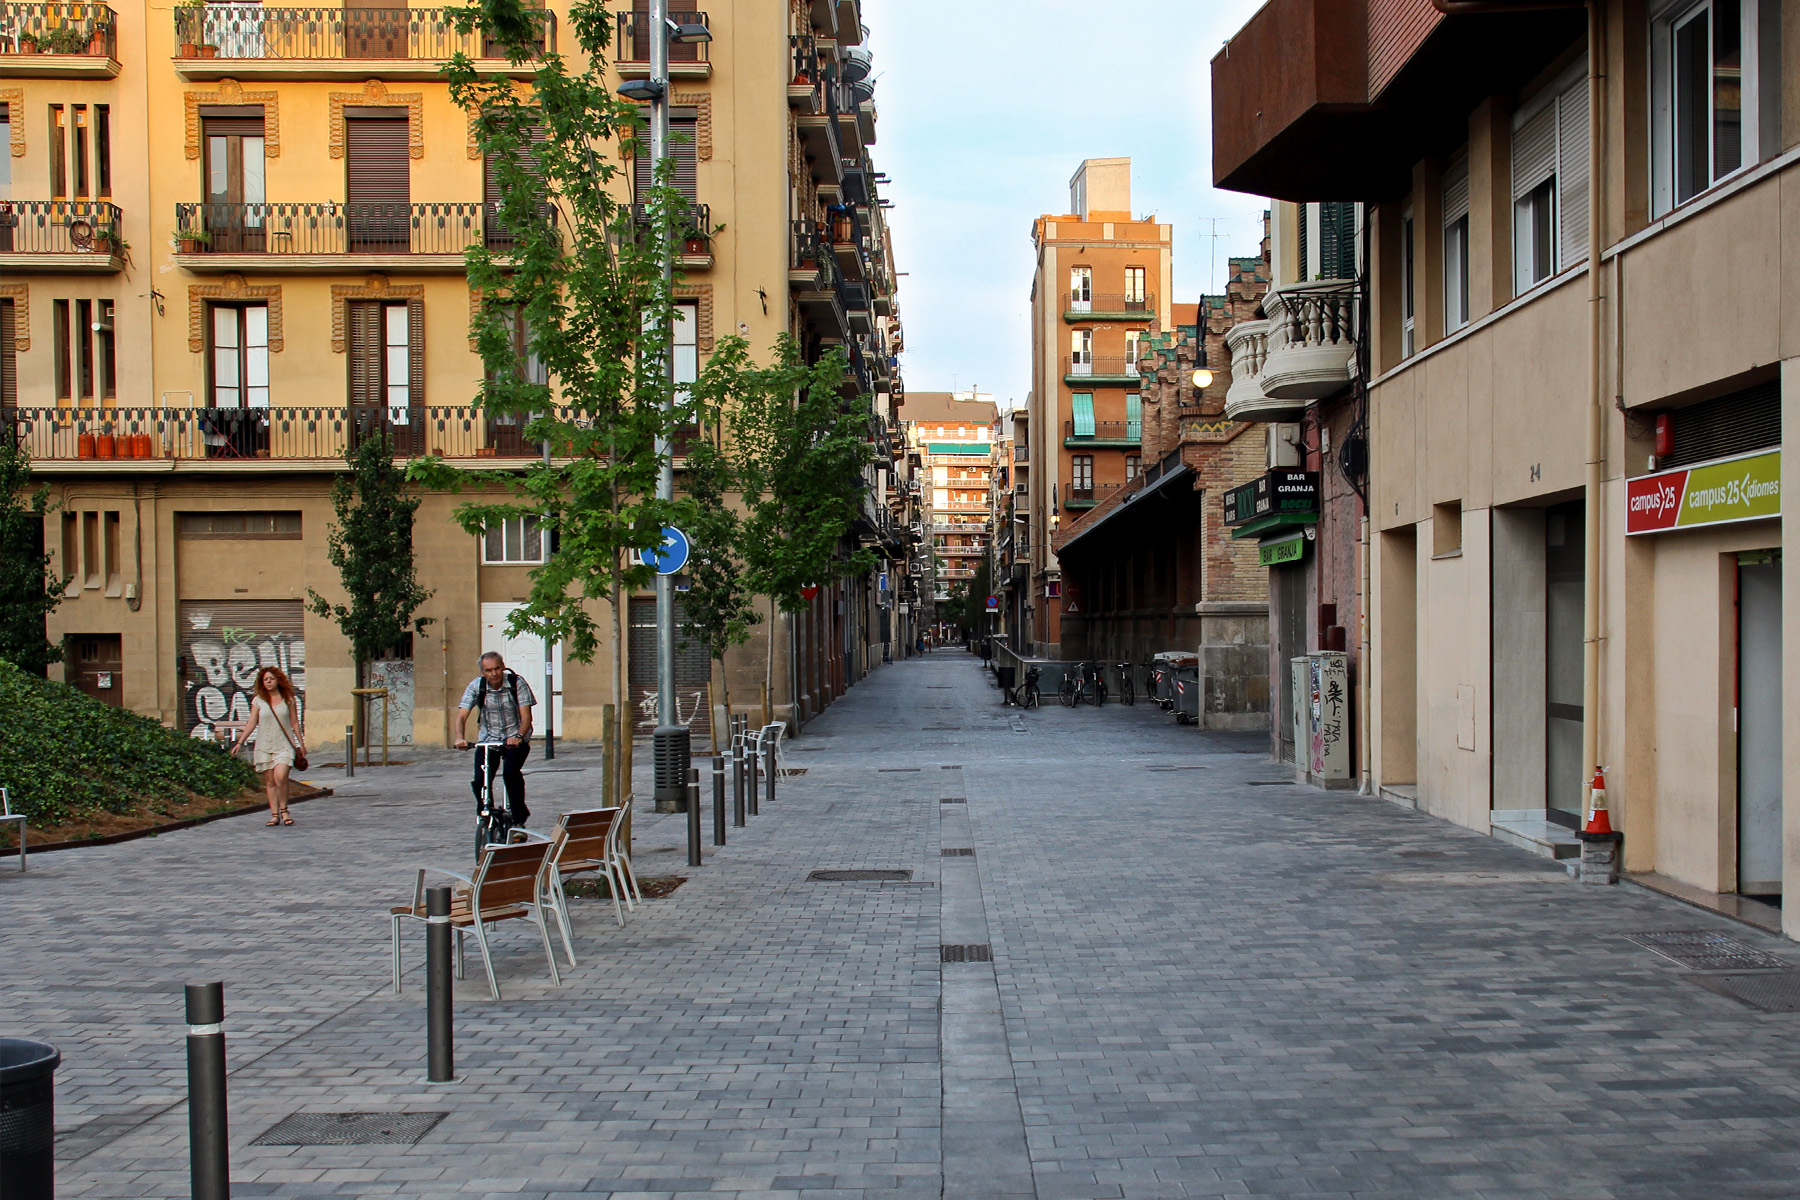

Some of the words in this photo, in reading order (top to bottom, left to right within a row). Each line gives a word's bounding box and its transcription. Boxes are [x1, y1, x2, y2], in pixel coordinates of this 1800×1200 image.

[1287, 473, 1305, 481] BAR
[1631, 492, 1660, 515] campus
[1664, 486, 1676, 509] 25
[1689, 486, 1726, 510] campus
[1727, 480, 1740, 504] 25
[1747, 480, 1779, 498] idiomes
[1256, 498, 1269, 513] GRANJA
[1281, 500, 1312, 508] ROCXI
[1263, 549, 1272, 562] BAR
[1277, 544, 1297, 560] GRANJA
